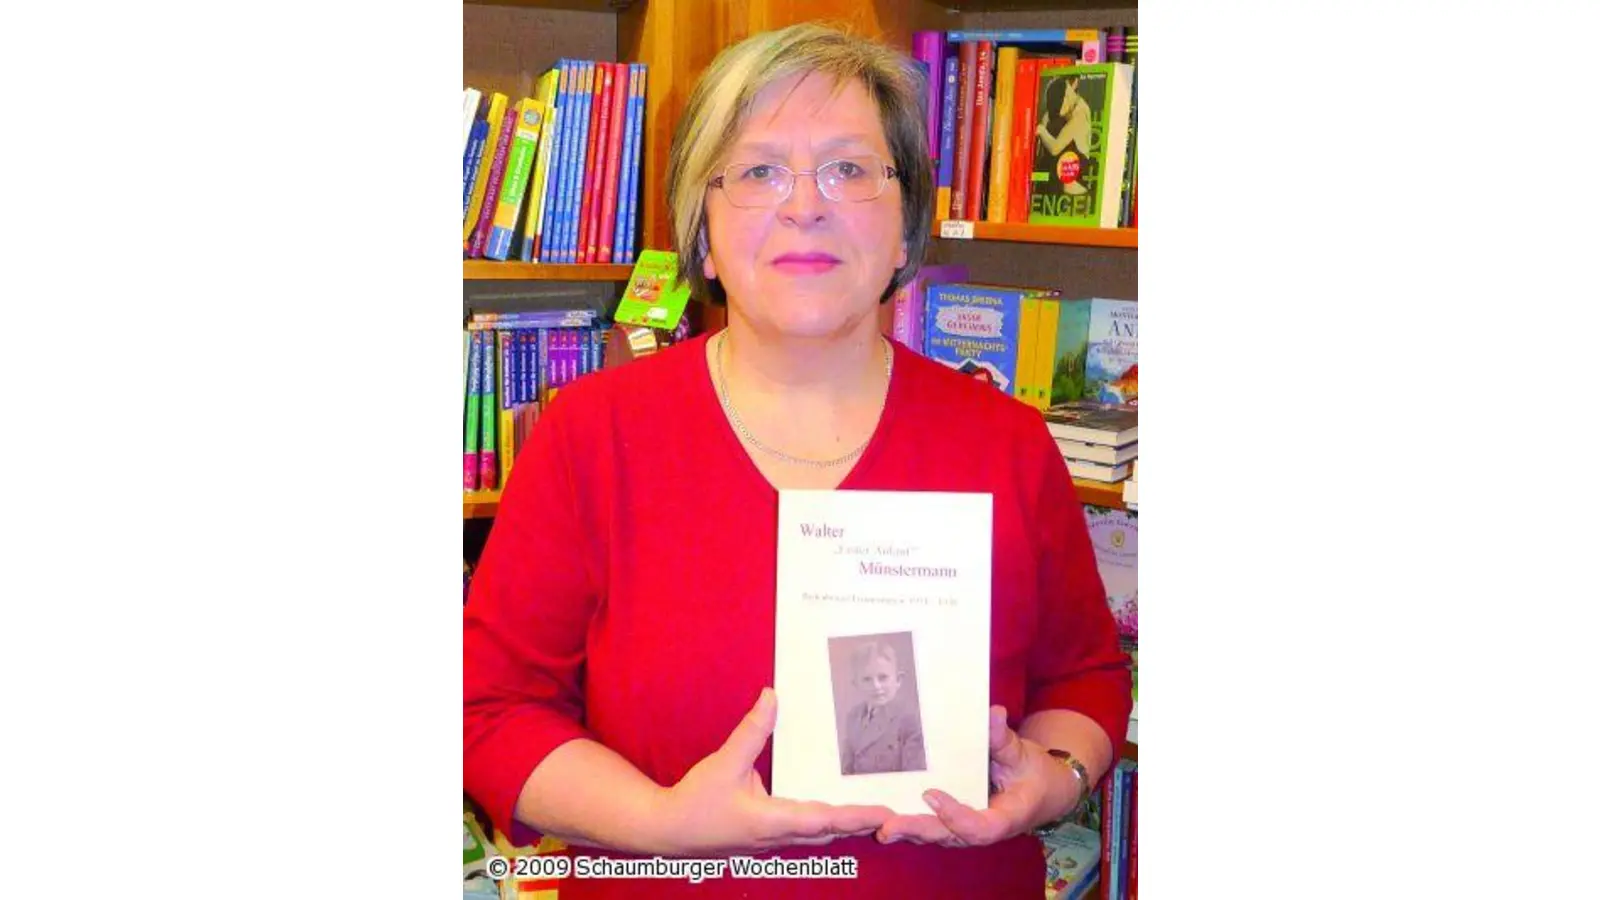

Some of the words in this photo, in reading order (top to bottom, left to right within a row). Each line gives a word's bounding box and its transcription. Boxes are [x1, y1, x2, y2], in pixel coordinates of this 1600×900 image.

[1031, 193, 1092, 218] ENGEL
[938, 292, 970, 303] THOMAS
[799, 521, 845, 539] Walter
[858, 558, 958, 579] Münstermann
